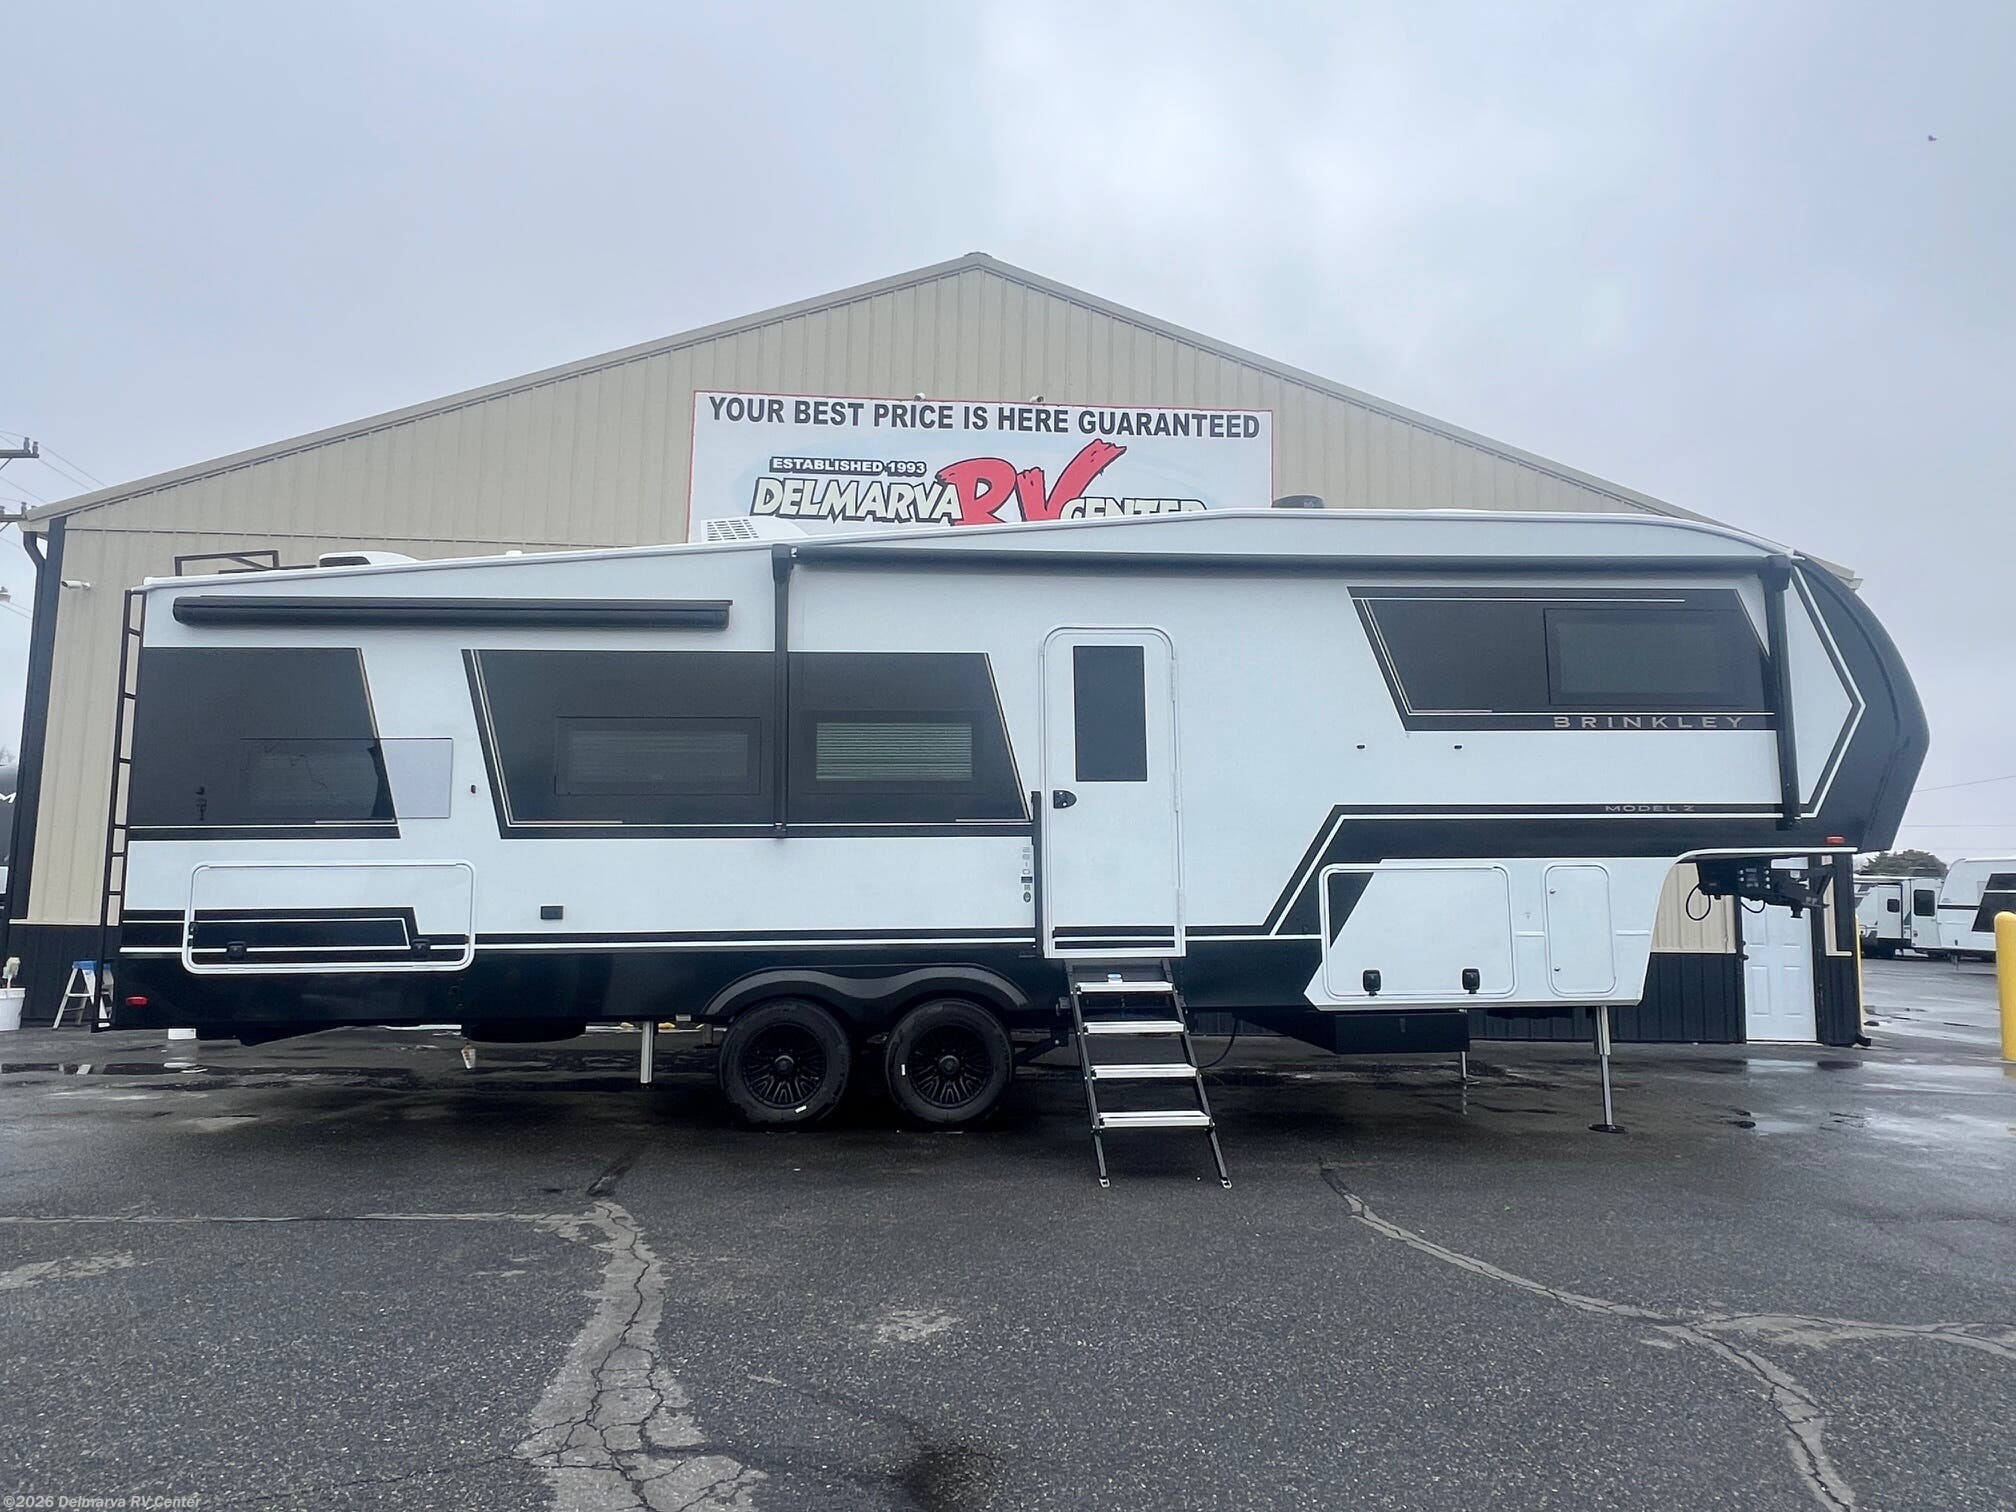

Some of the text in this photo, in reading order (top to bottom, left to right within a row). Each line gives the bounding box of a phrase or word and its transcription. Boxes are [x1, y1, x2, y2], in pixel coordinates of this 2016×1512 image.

[709, 396, 1260, 438] YOUR BEST PRICE IS HERE GUARANTEED
[772, 457, 926, 474] ESTABLISHED 1993
[750, 477, 963, 523] DELMARVA
[935, 438, 1128, 526] RV
[1554, 716, 1744, 728] BRINKLEY
[1605, 805, 1696, 813] MODEL Z
